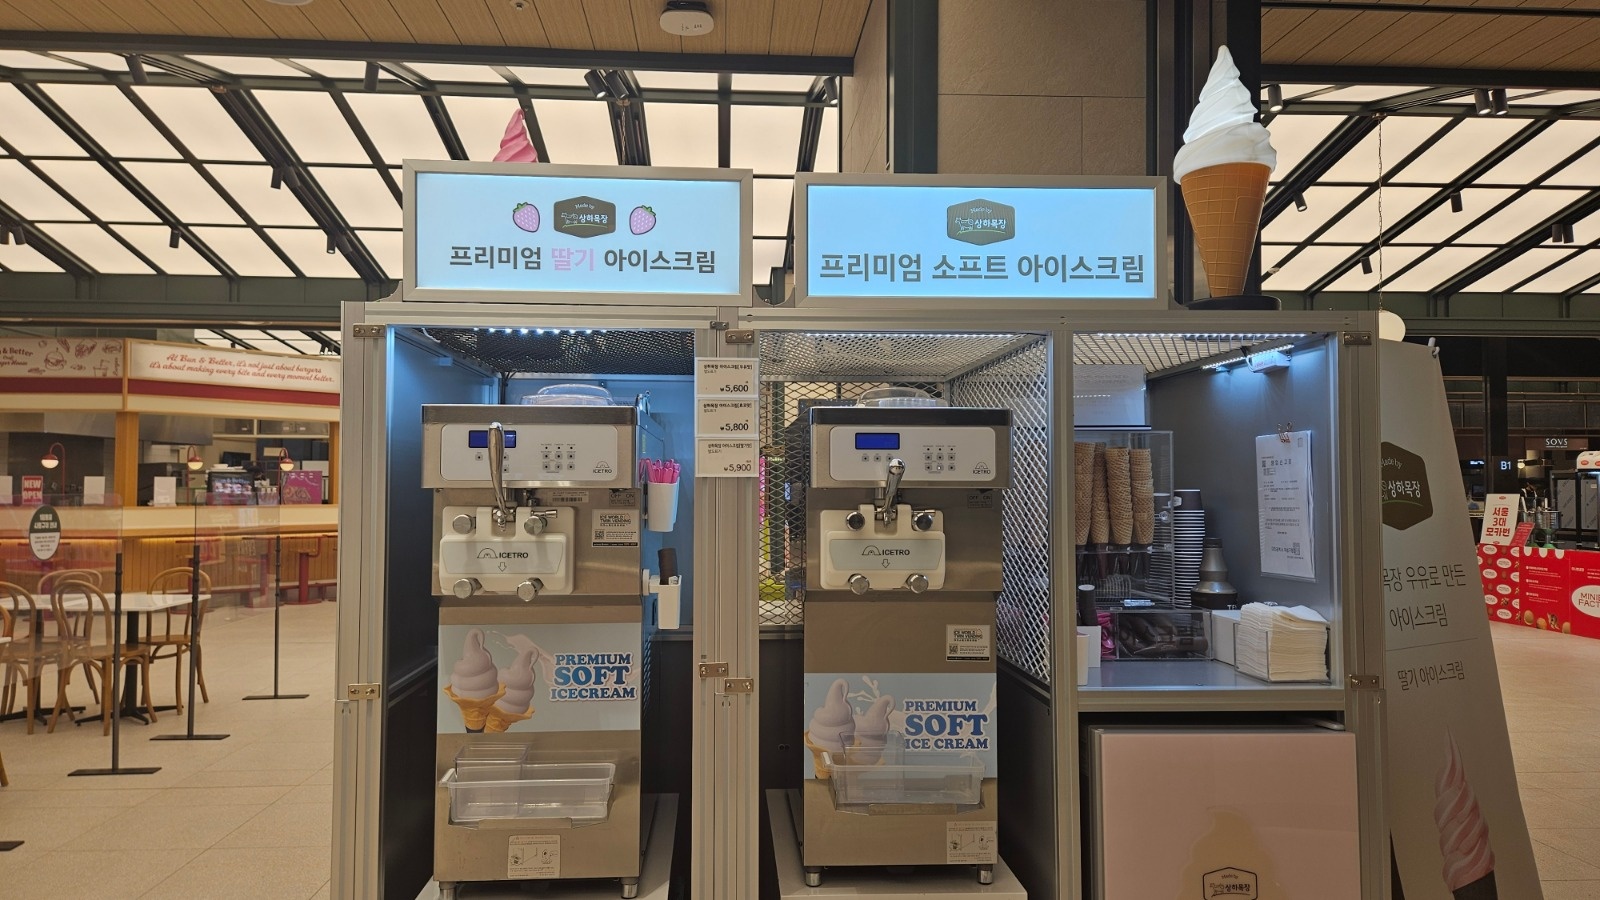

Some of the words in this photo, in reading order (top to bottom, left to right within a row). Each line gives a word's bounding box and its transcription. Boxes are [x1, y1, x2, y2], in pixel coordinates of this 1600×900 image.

[578, 214, 609, 224] 상하목장
[974, 219, 1006, 230] 상하목장
[450, 246, 542, 270] 프리미엄
[551, 248, 595, 272] 딸기
[604, 250, 716, 274] 아이스크림
[820, 253, 922, 283] 프리미엄
[932, 255, 1009, 280] 소프트
[1017, 254, 1144, 284] 아이스크림
[180, 354, 197, 363] Bun
[260, 362, 274, 372] just
[276, 363, 296, 372] about
[296, 364, 322, 374] burgers
[162, 362, 186, 371] about
[186, 366, 214, 376] making
[216, 369, 236, 378] every
[237, 368, 251, 377] bite
[266, 372, 286, 381] every
[1500, 461, 1512, 470] B1
[24, 480, 42, 488] NEW
[1388, 480, 1421, 498] 상하목장
[24, 491, 43, 500] OPEN
[1492, 507, 1509, 517] 서울
[1492, 517, 1506, 527] 3대
[1485, 527, 1511, 537] 모카번
[1406, 566, 1442, 590] 우유로
[1442, 563, 1467, 588] 만든
[1389, 603, 1448, 631] 아이스크림
[555, 653, 631, 665] PREMIUM
[554, 666, 631, 685] SOFT
[1398, 668, 1419, 691] 딸기
[1419, 660, 1465, 687] 아이스크림
[551, 688, 636, 699] ICECREAM
[905, 701, 977, 711] PREMIUM
[905, 714, 988, 736] SOFT
[905, 739, 930, 749] ICE
[934, 738, 988, 749] CREAM
[1225, 884, 1250, 892] 상하목장
